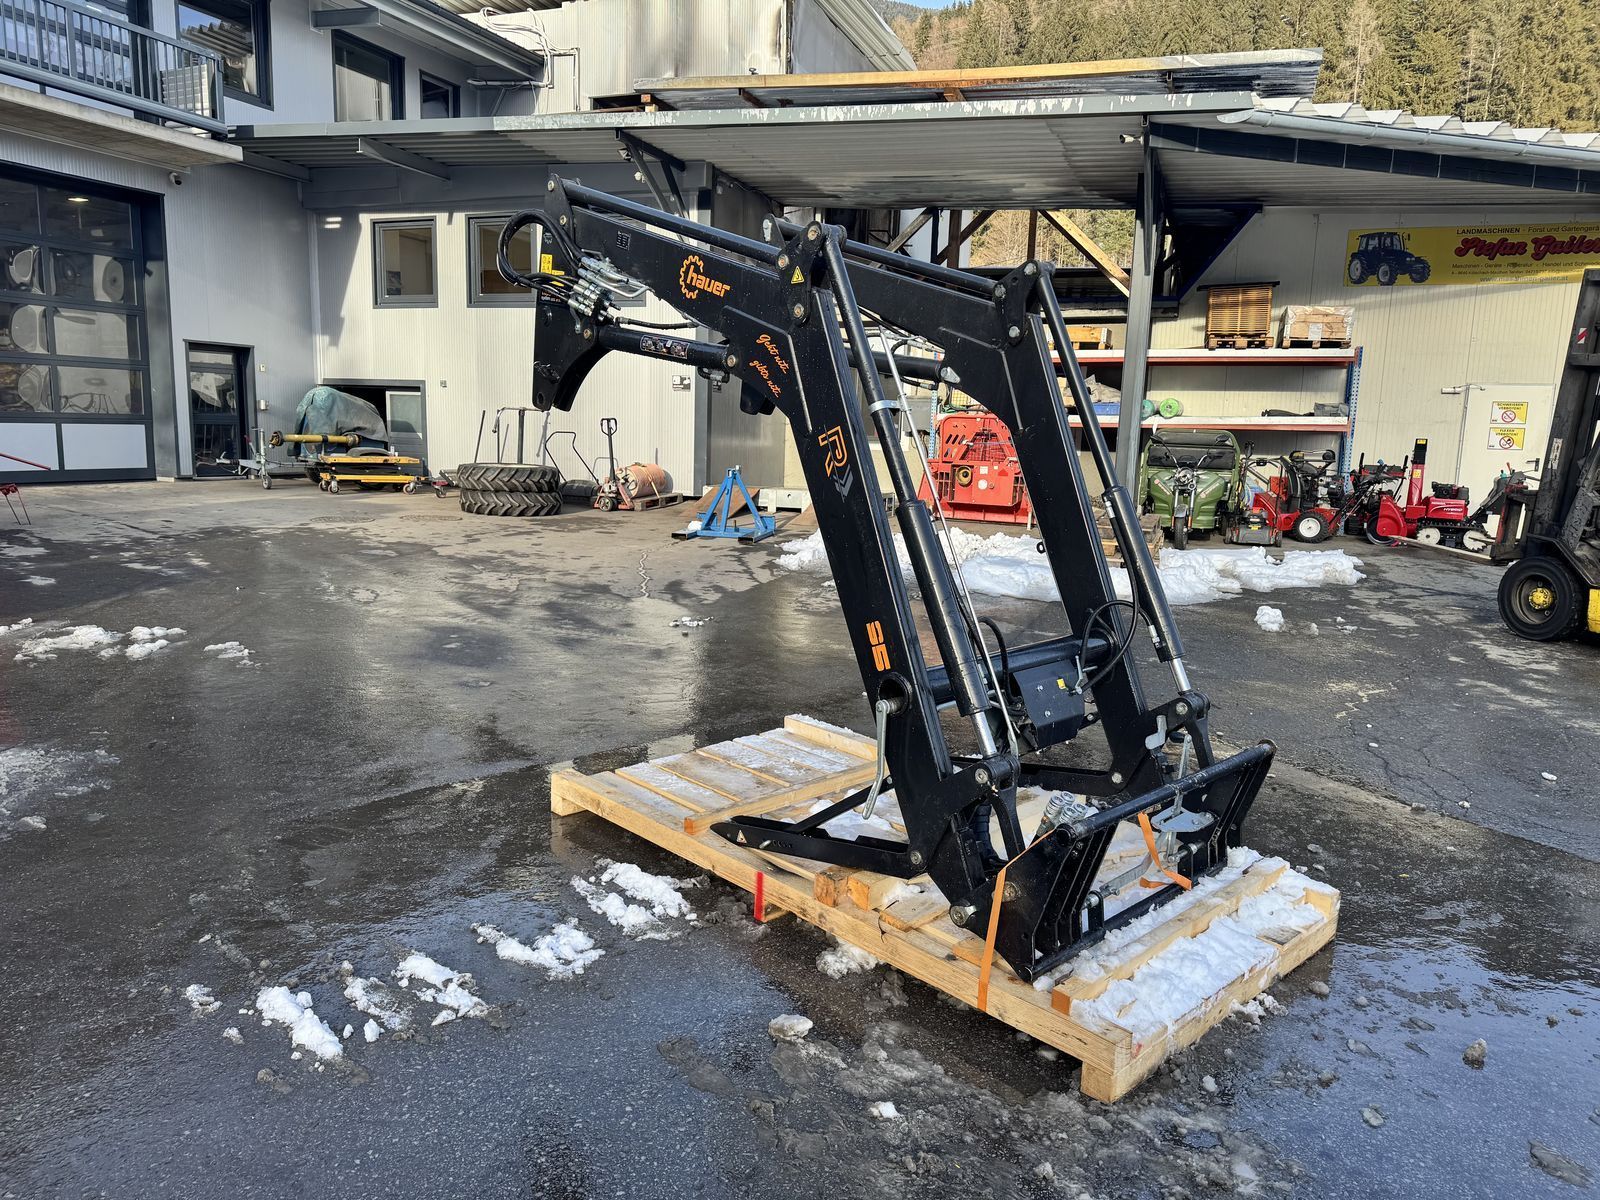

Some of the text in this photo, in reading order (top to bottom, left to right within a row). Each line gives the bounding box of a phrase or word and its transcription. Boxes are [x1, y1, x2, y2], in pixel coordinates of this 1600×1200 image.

[1456, 227, 1521, 235] LANDMASCHINEN
[1454, 237, 1528, 260] Stefan
[686, 264, 731, 297] hauer
